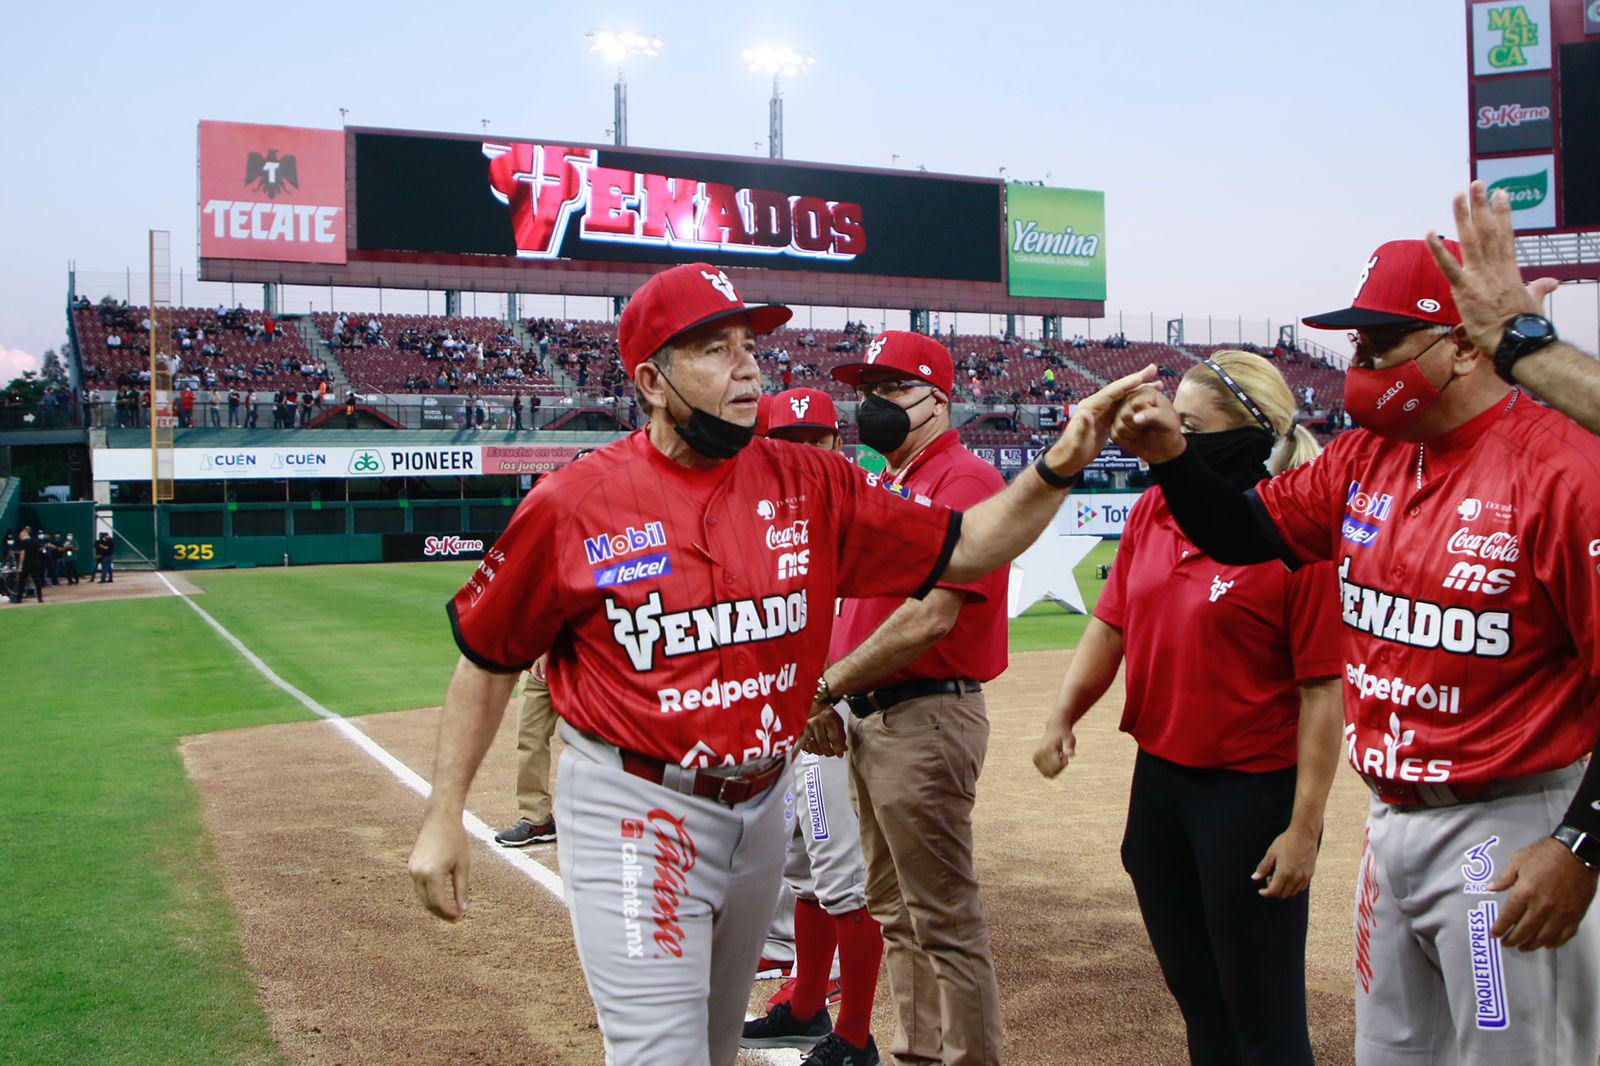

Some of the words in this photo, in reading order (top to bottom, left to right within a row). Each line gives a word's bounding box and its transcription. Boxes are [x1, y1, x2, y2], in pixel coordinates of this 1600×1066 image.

[1477, 104, 1549, 128] SuKarne
[482, 142, 868, 260] VENADOS
[1487, 186, 1544, 202] norr
[203, 199, 340, 243] TECATE
[1012, 218, 1099, 258] Yemina
[1376, 380, 1404, 410] JOSELO
[391, 451, 474, 470] PIONEER
[487, 447, 533, 458] Escucha
[536, 448, 551, 458] en
[500, 460, 517, 471] los
[517, 461, 556, 473] juegos
[174, 544, 214, 560] 325
[424, 536, 483, 555] SuKarne
[583, 521, 667, 565] Mobil
[1447, 527, 1520, 563] Coca-Cola
[616, 556, 667, 583] telcel
[1442, 561, 1516, 596] ms
[1338, 556, 1512, 658] ENADOS
[657, 662, 797, 713] Redpetroil
[1346, 663, 1460, 714] edpetroil
[806, 771, 822, 833] PAQUETEXPRESS
[620, 842, 644, 959] caliente.mx
[647, 808, 697, 959] Caliente
[1471, 910, 1494, 1015] PAQUETEXPRESS
